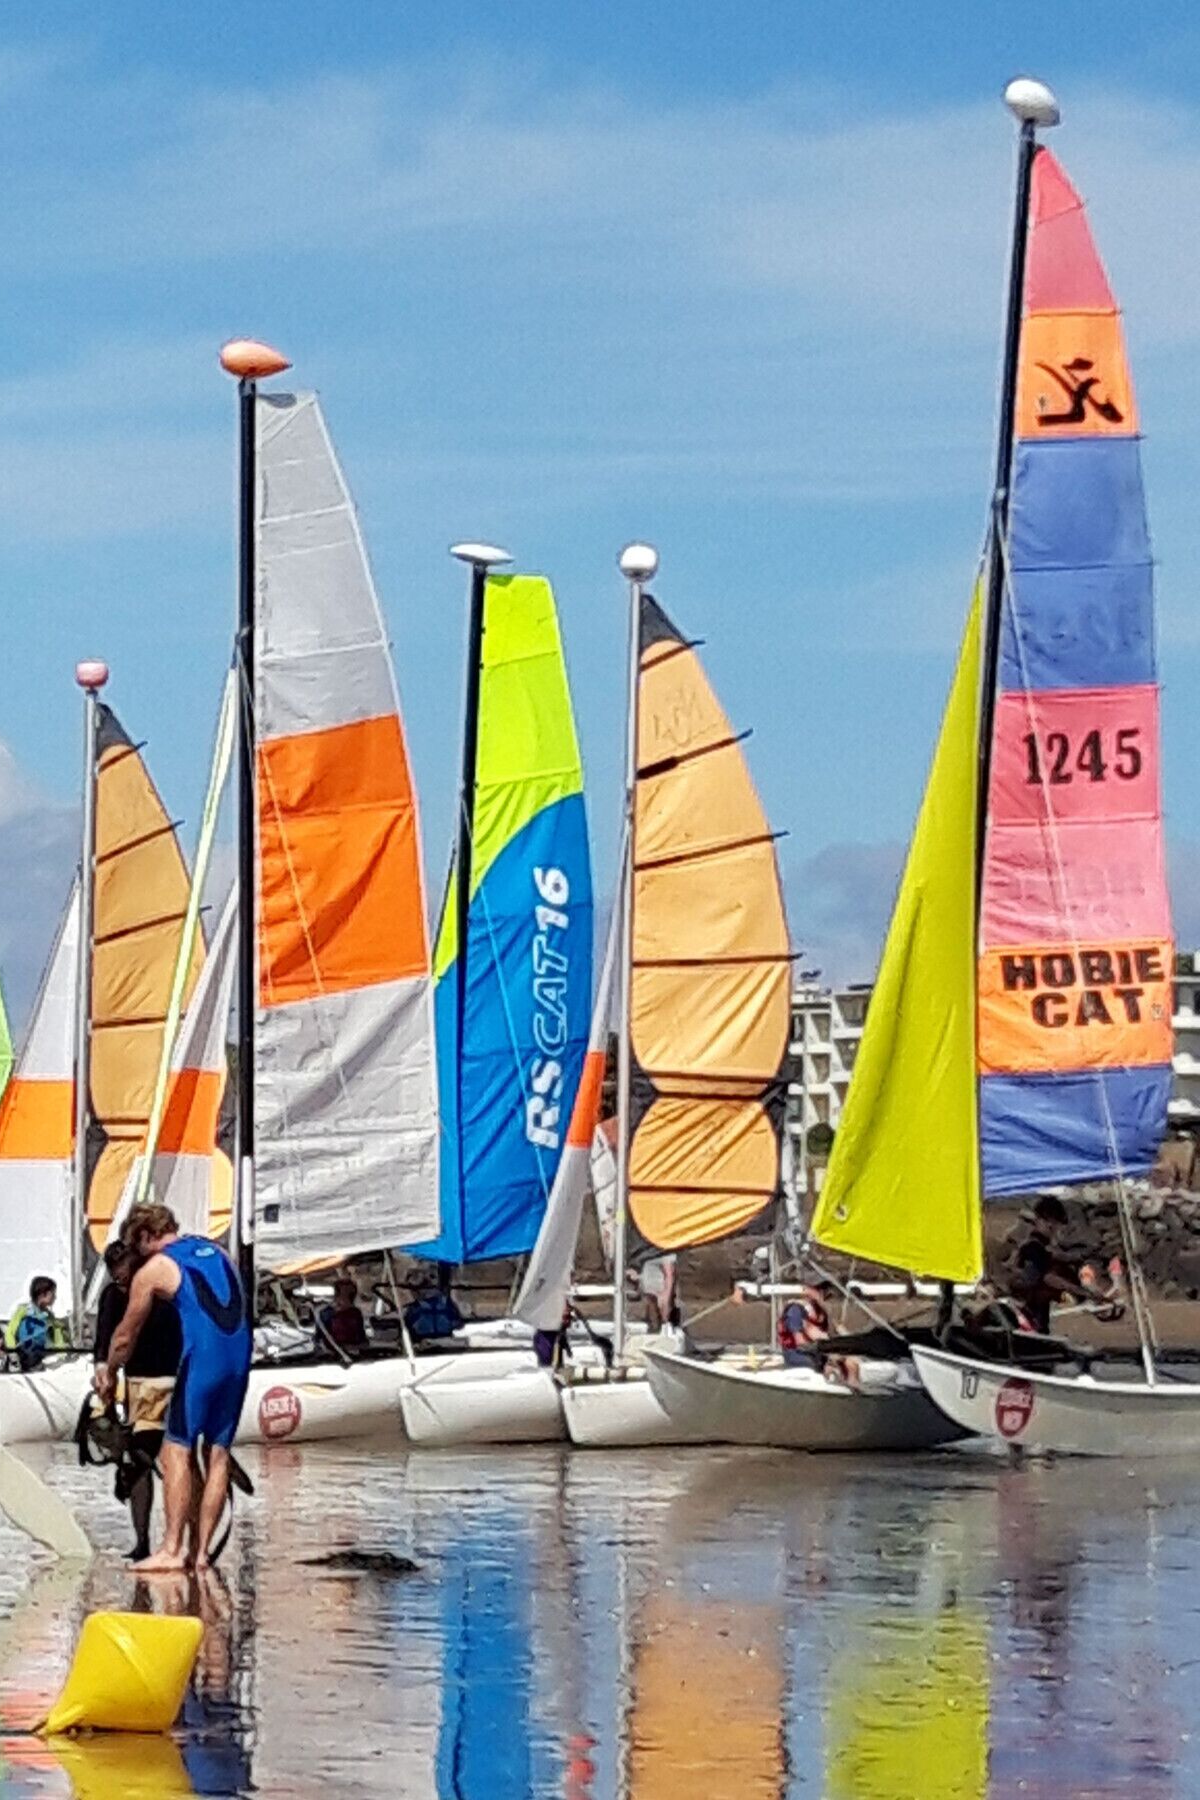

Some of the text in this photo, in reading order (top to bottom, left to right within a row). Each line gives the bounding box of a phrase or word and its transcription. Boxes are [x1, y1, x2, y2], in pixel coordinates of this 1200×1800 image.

[1022, 727, 1142, 785] 1245
[1000, 947, 1165, 991] HOBIE
[1031, 988, 1144, 1028] CAT
